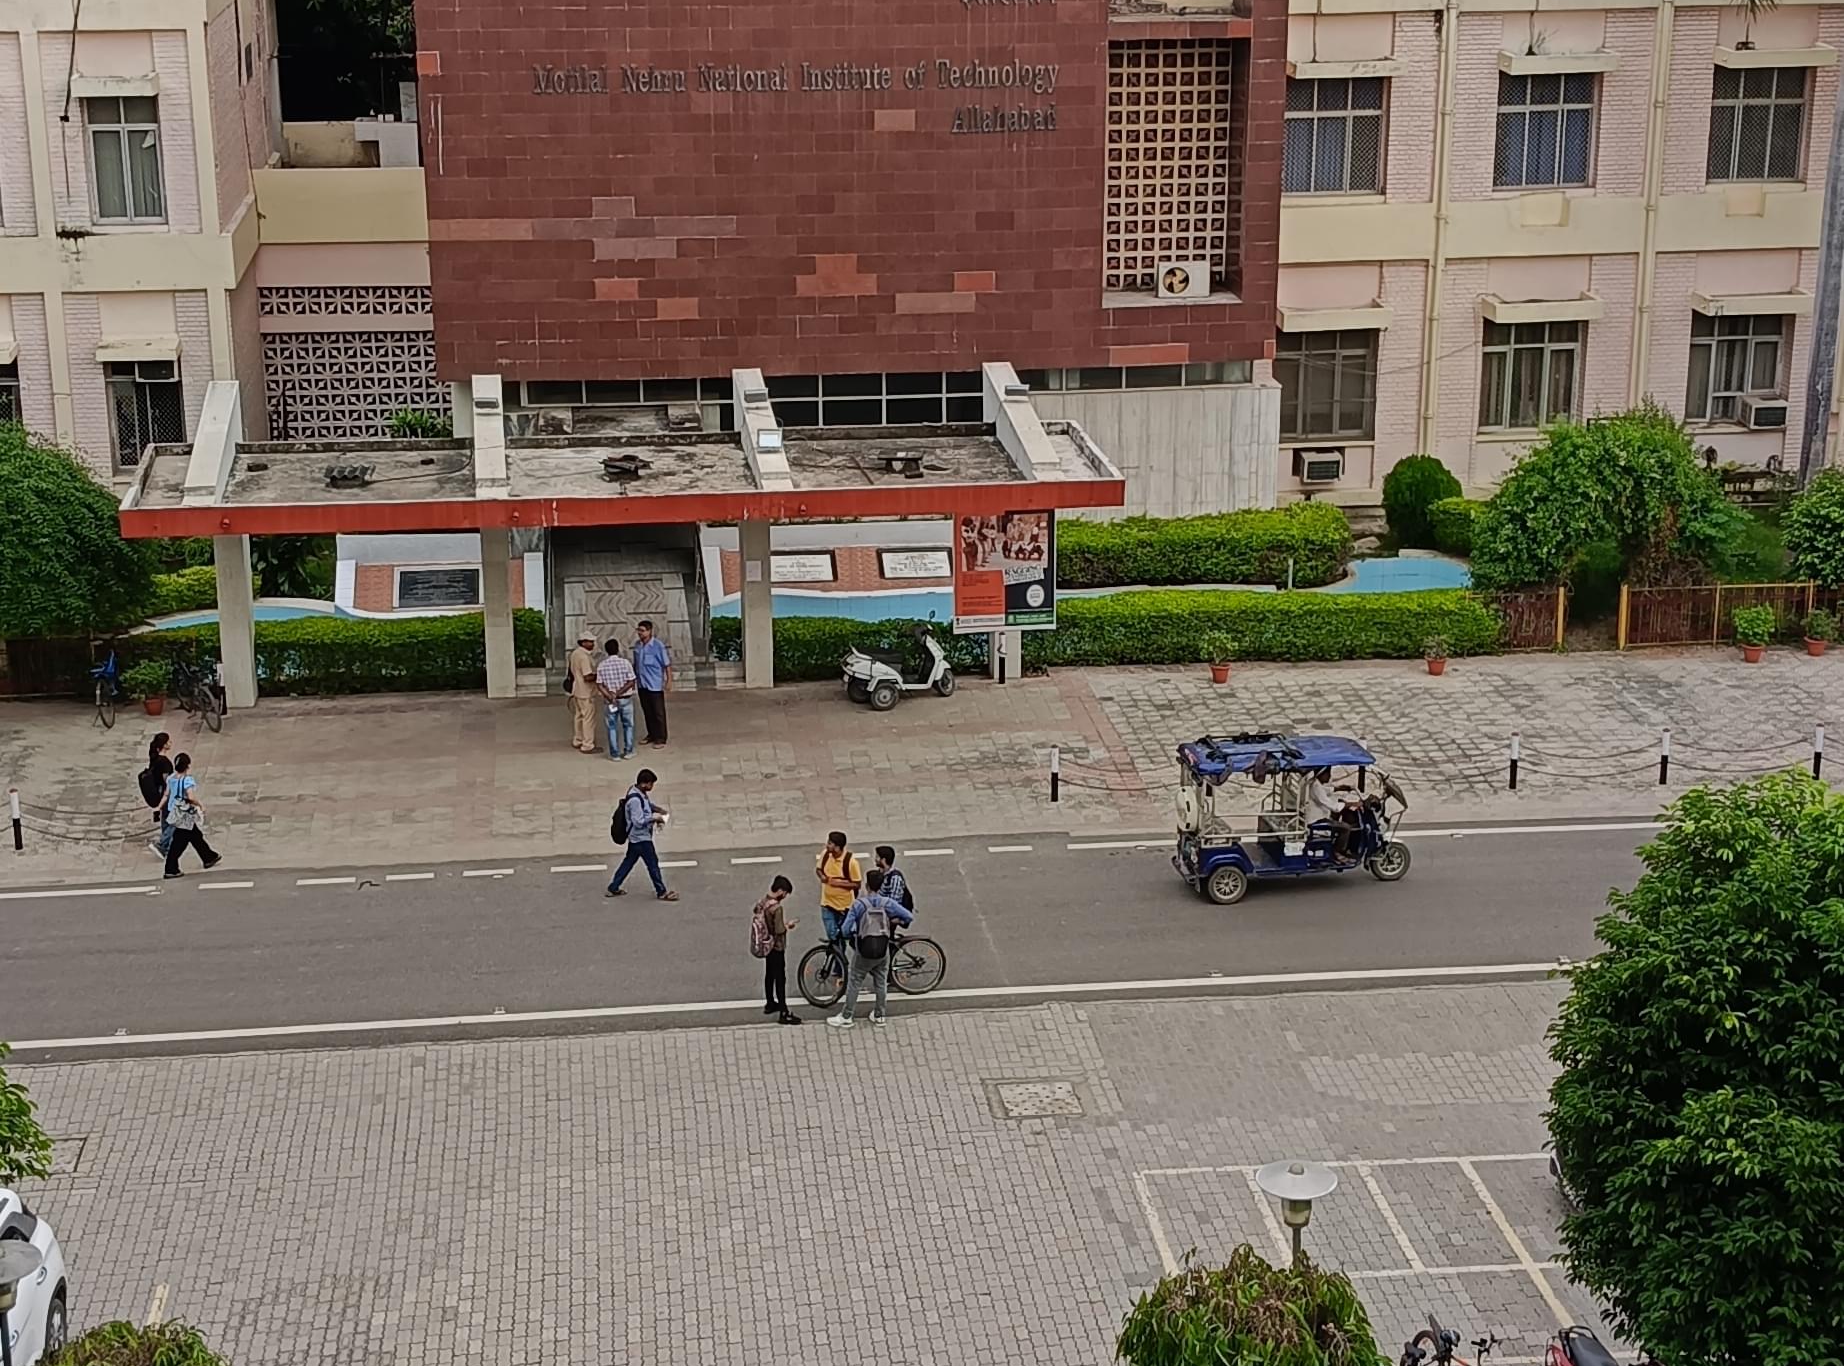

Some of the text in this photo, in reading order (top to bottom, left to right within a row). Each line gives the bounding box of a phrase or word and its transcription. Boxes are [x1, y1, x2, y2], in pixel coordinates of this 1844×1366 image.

[621, 63, 686, 93] Nehru
[698, 62, 789, 92] National
[801, 61, 892, 91] Institute
[905, 60, 926, 90] of
[936, 59, 1059, 94] Technology
[951, 102, 1057, 134] Allahabad
